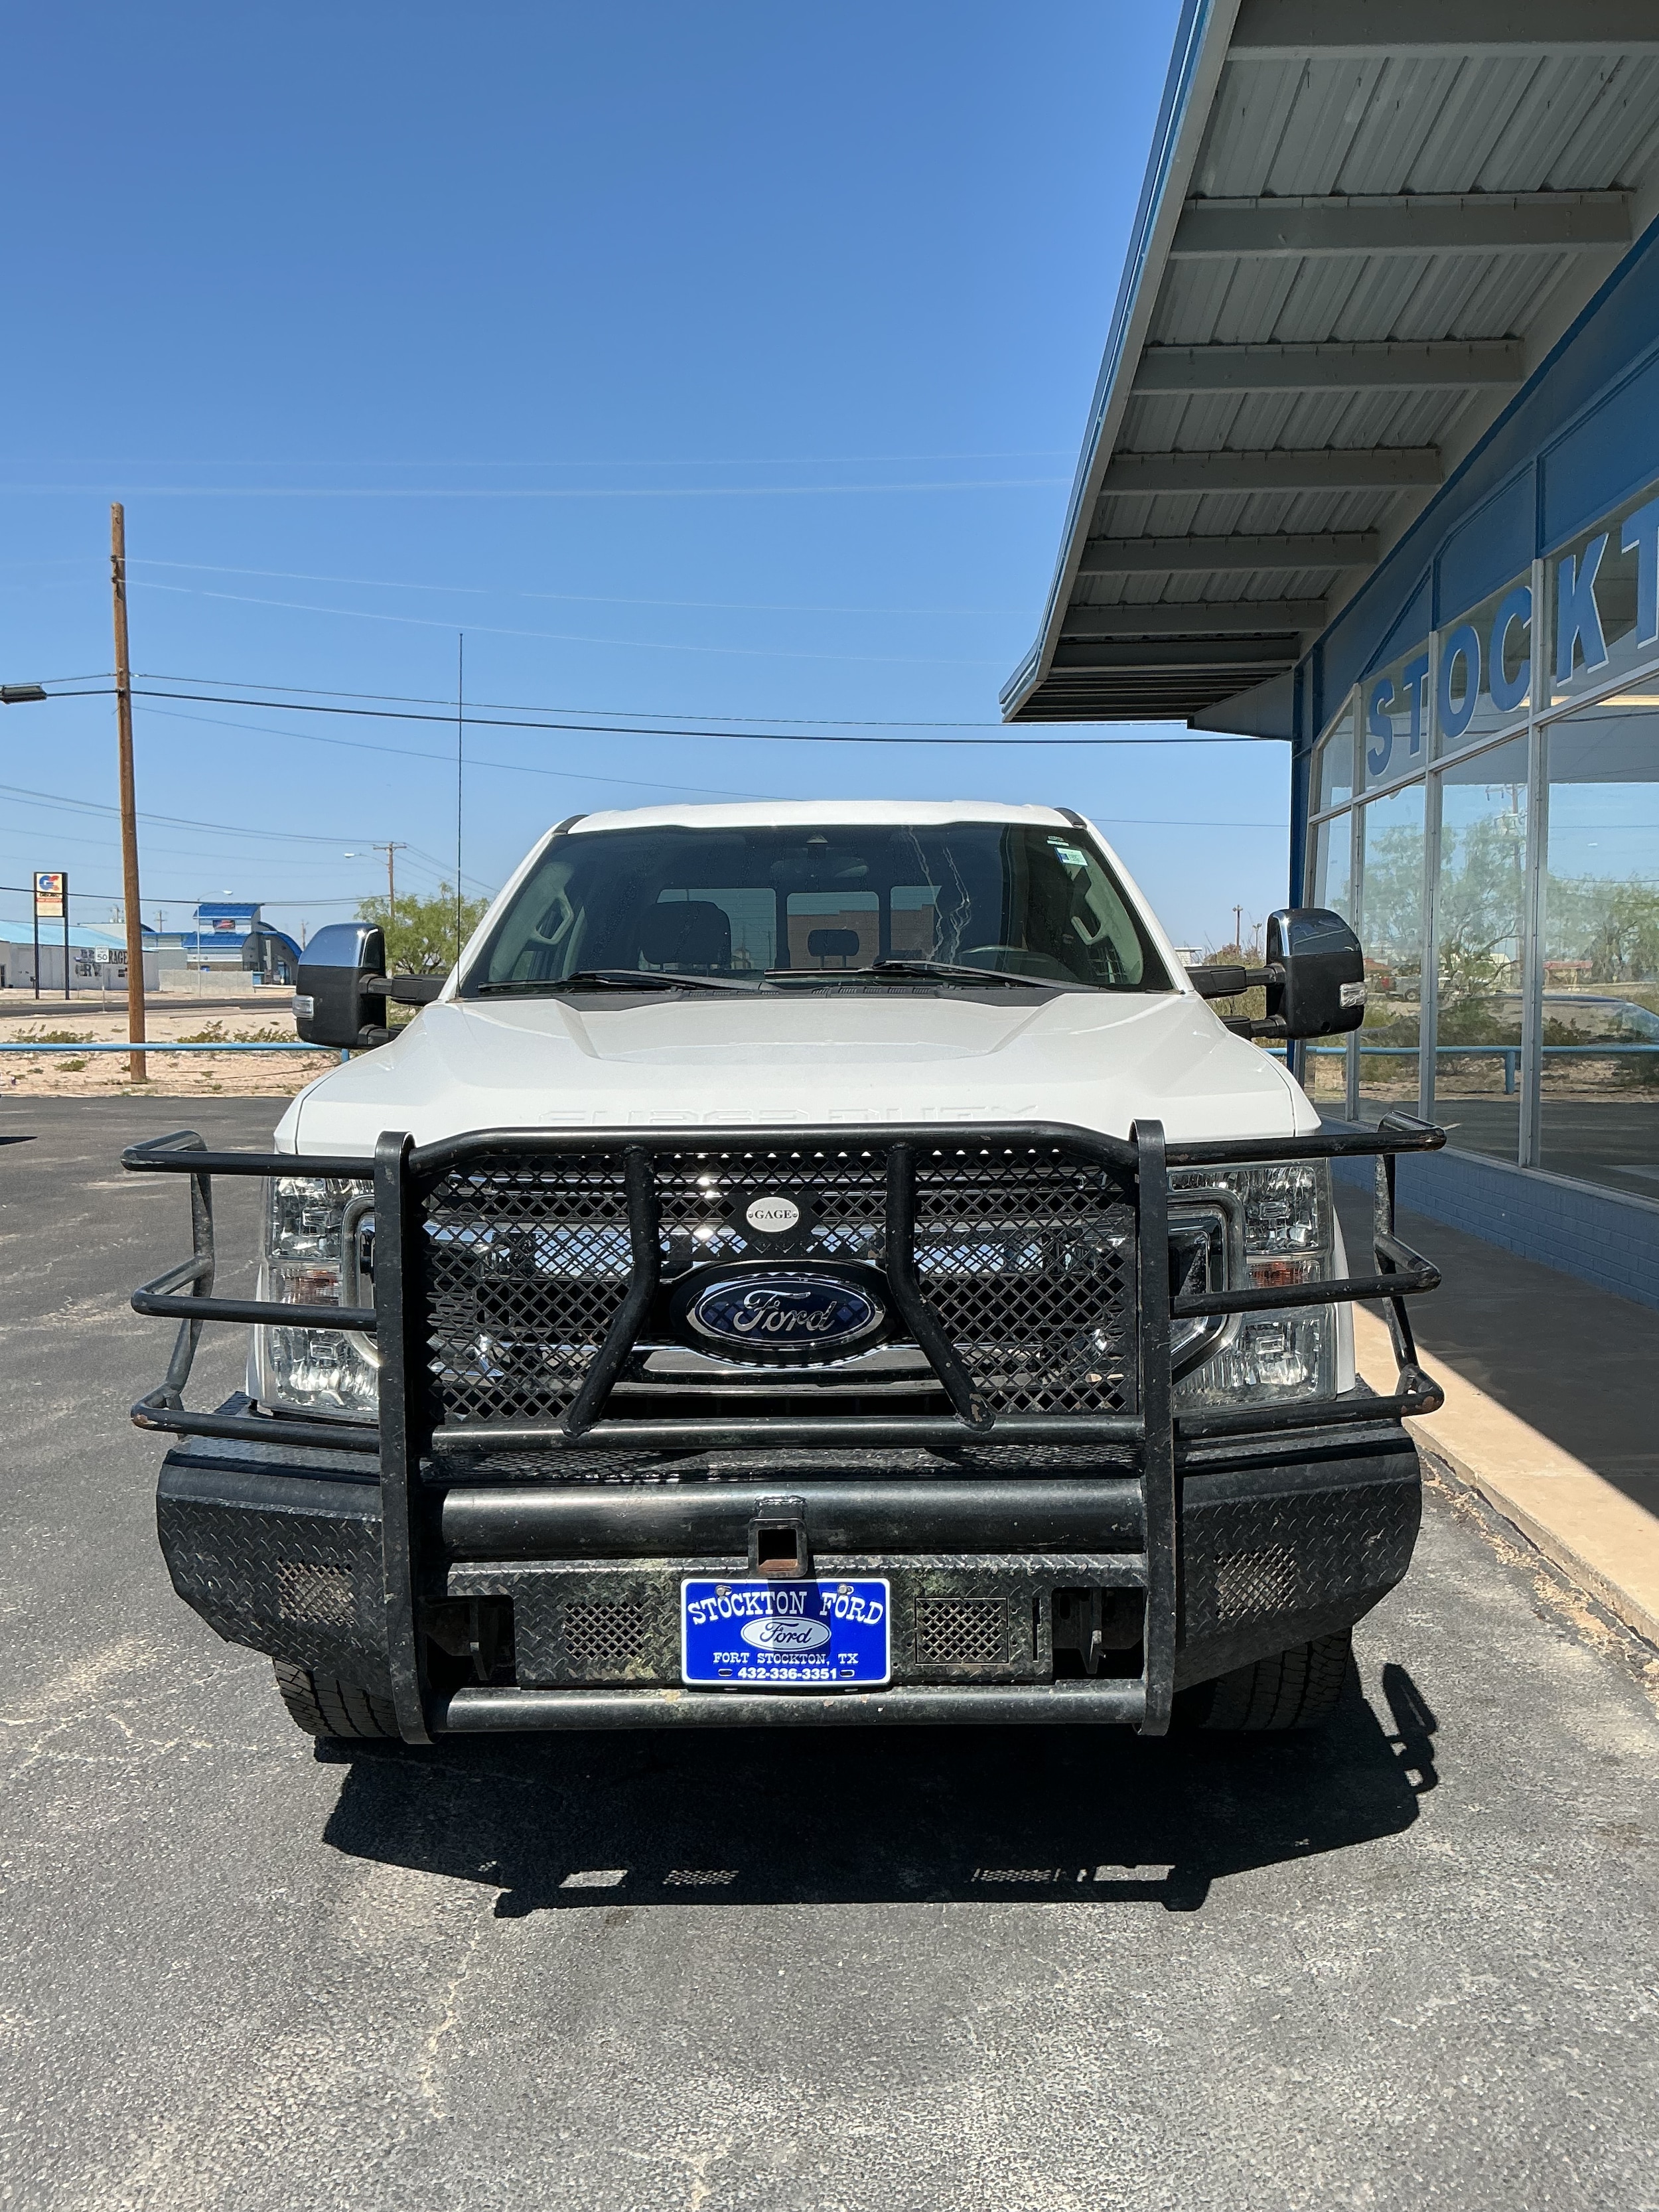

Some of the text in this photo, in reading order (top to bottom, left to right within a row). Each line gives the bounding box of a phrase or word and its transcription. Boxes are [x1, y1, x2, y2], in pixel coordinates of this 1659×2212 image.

[755, 1209, 792, 1220] GAGE
[733, 1290, 837, 1332] Ford
[687, 1591, 884, 1625] STOCKTON FORD
[760, 1621, 814, 1645] Ford
[713, 1652, 859, 1666] FORT STOCKTON, TX
[737, 1666, 837, 1680] 432-336-3351
